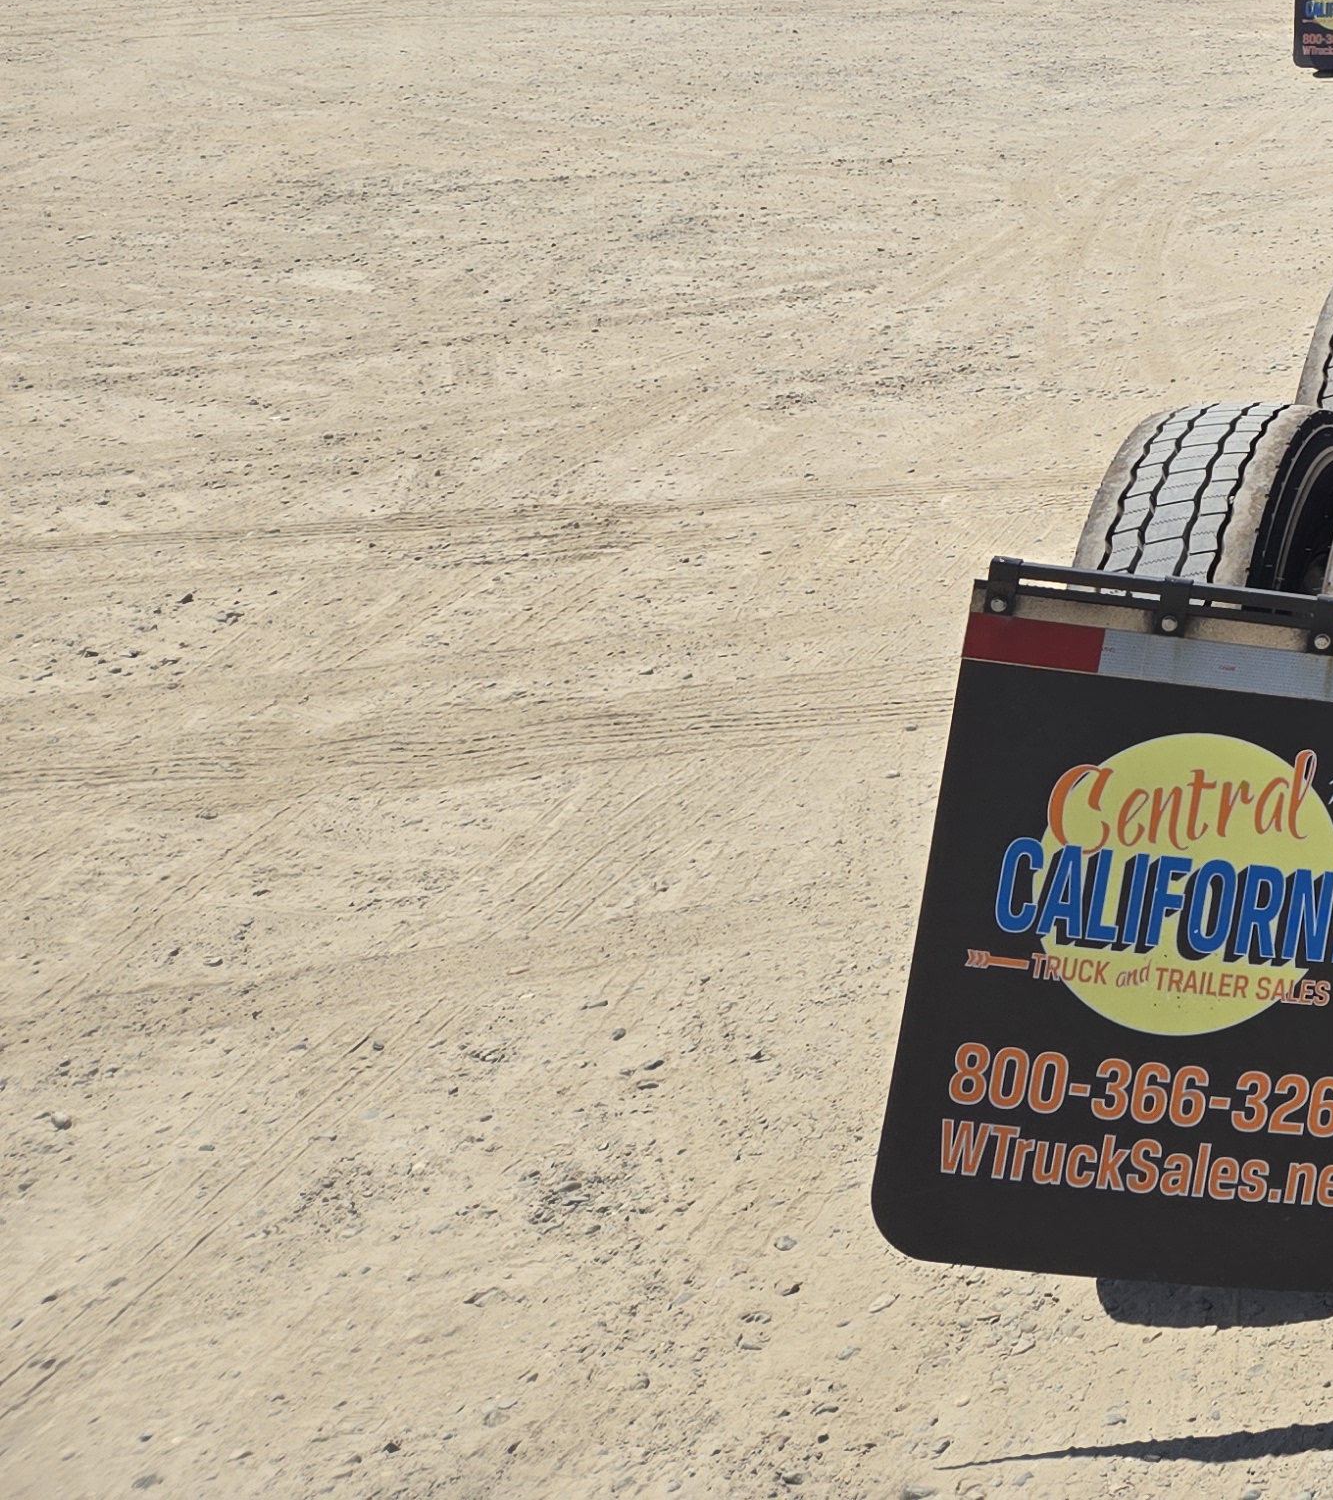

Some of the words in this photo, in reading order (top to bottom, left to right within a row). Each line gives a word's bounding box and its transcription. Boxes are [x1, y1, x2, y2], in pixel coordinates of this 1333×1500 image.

[1047, 749, 1318, 855] Central
[1031, 952, 1108, 985] TRUCK
[1115, 959, 1152, 989] and
[1155, 966, 1248, 1000] TRAILER
[1255, 975, 1331, 1007] SALES
